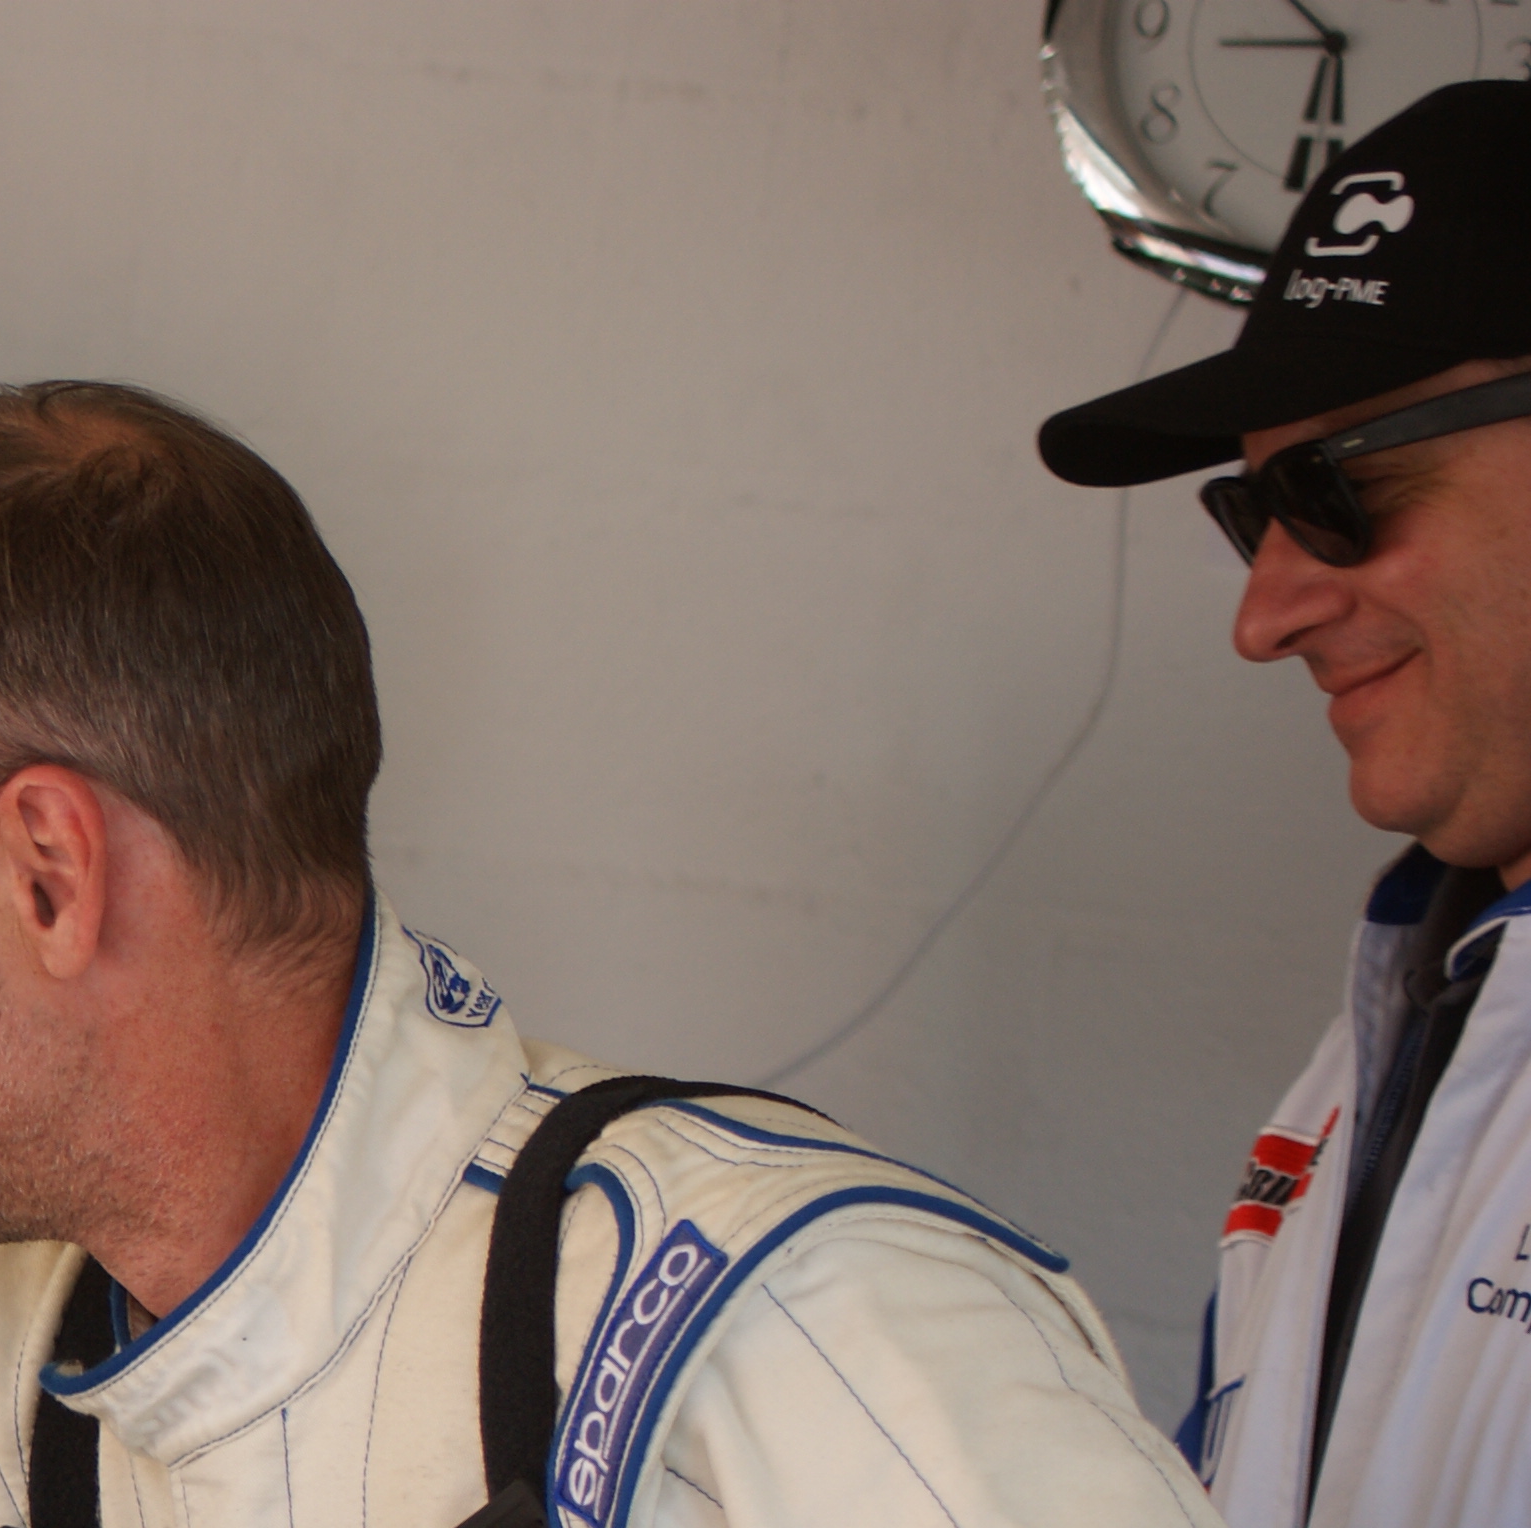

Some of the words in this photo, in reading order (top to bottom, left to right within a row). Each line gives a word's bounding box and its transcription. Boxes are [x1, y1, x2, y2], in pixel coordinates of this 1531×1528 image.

[1140, 82, 1181, 144] 8
[1198, 157, 1238, 219] 7
[568, 1244, 698, 1506] sparco
